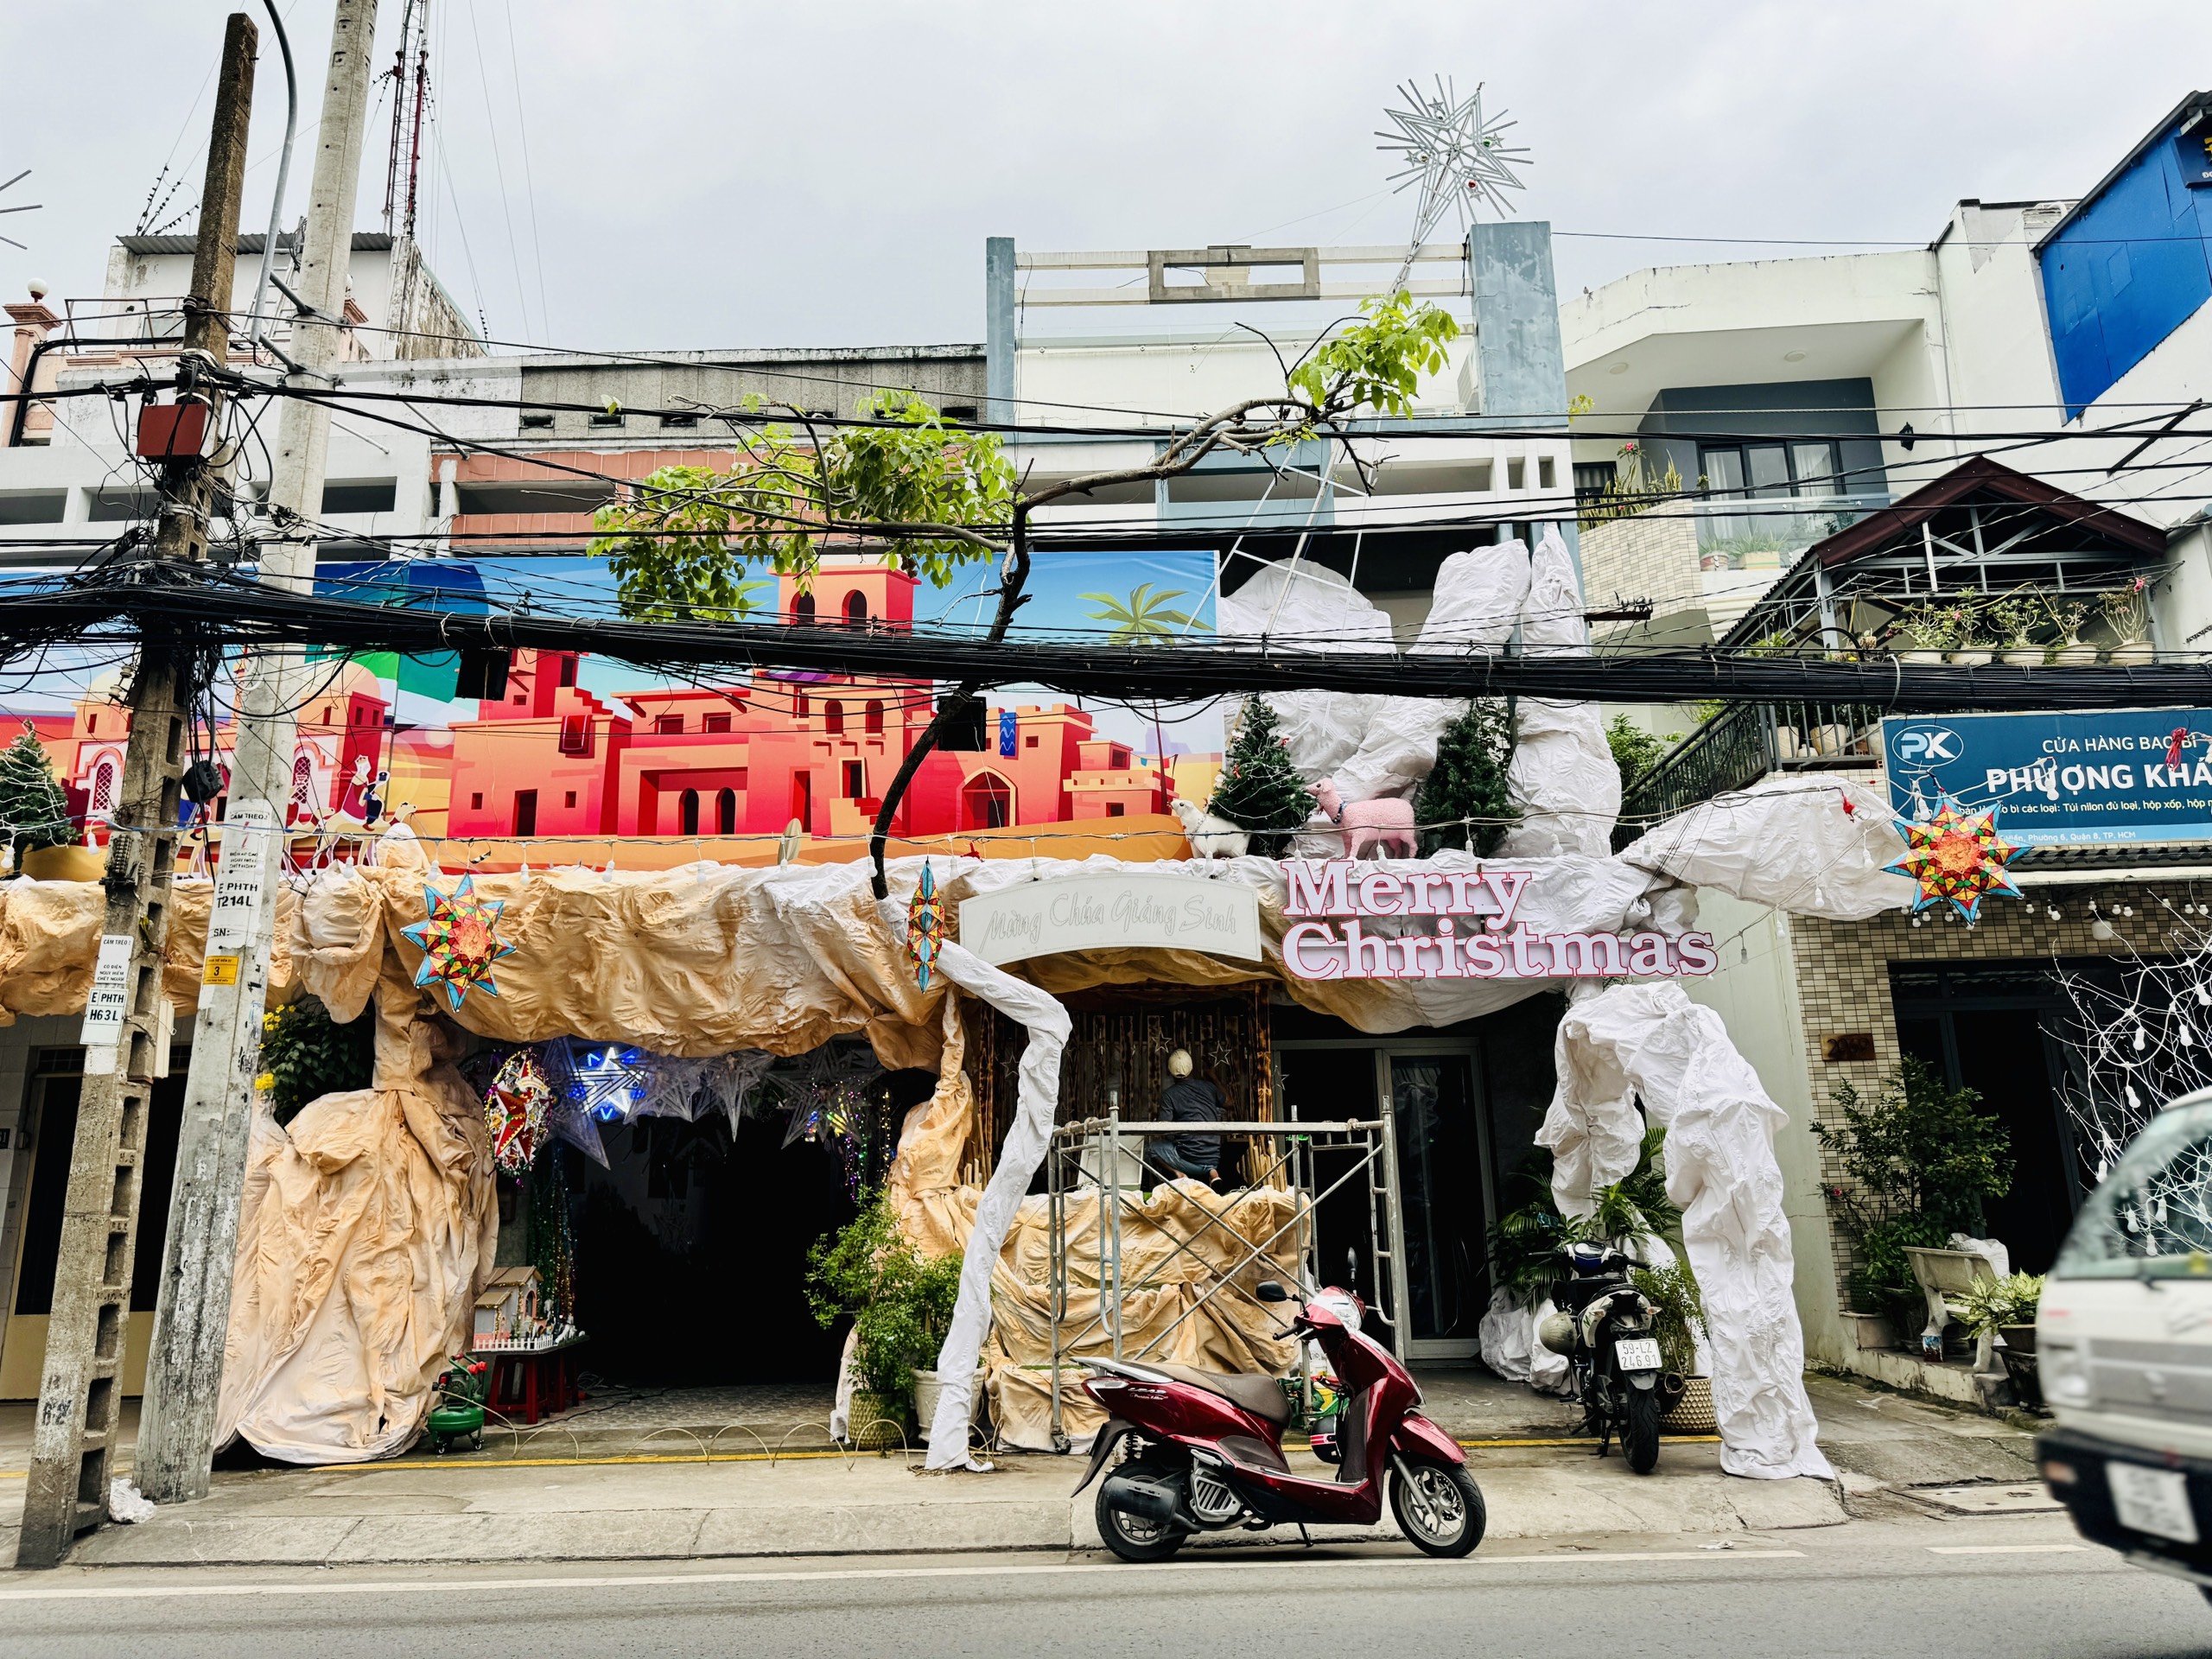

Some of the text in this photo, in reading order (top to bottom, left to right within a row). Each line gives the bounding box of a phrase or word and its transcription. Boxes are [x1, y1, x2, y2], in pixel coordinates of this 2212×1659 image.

[1901, 732, 1956, 760] PK
[2043, 736, 2081, 754] CỬA
[2085, 734, 2134, 753] HÀNG
[2139, 735, 2174, 750] BAO
[1986, 764, 2134, 796] PHƯỢNG
[2021, 804, 2039, 814] các
[2063, 802, 2079, 812] Túi
[2081, 802, 2104, 812] nilon
[2143, 799, 2162, 811] hộp
[2186, 798, 2206, 810] hộp
[2117, 830, 2137, 840] HCM
[218, 882, 258, 893] E PHTH
[1280, 860, 1533, 931] Merry
[1049, 891, 1105, 927] Chúa
[1111, 889, 1177, 937] Giáng
[1178, 894, 1236, 935] Sinh
[1281, 915, 1719, 981] Christmas
[213, 965, 220, 976] 3
[91, 992, 124, 1003] E PHTH
[89, 1008, 119, 1021] H63L
